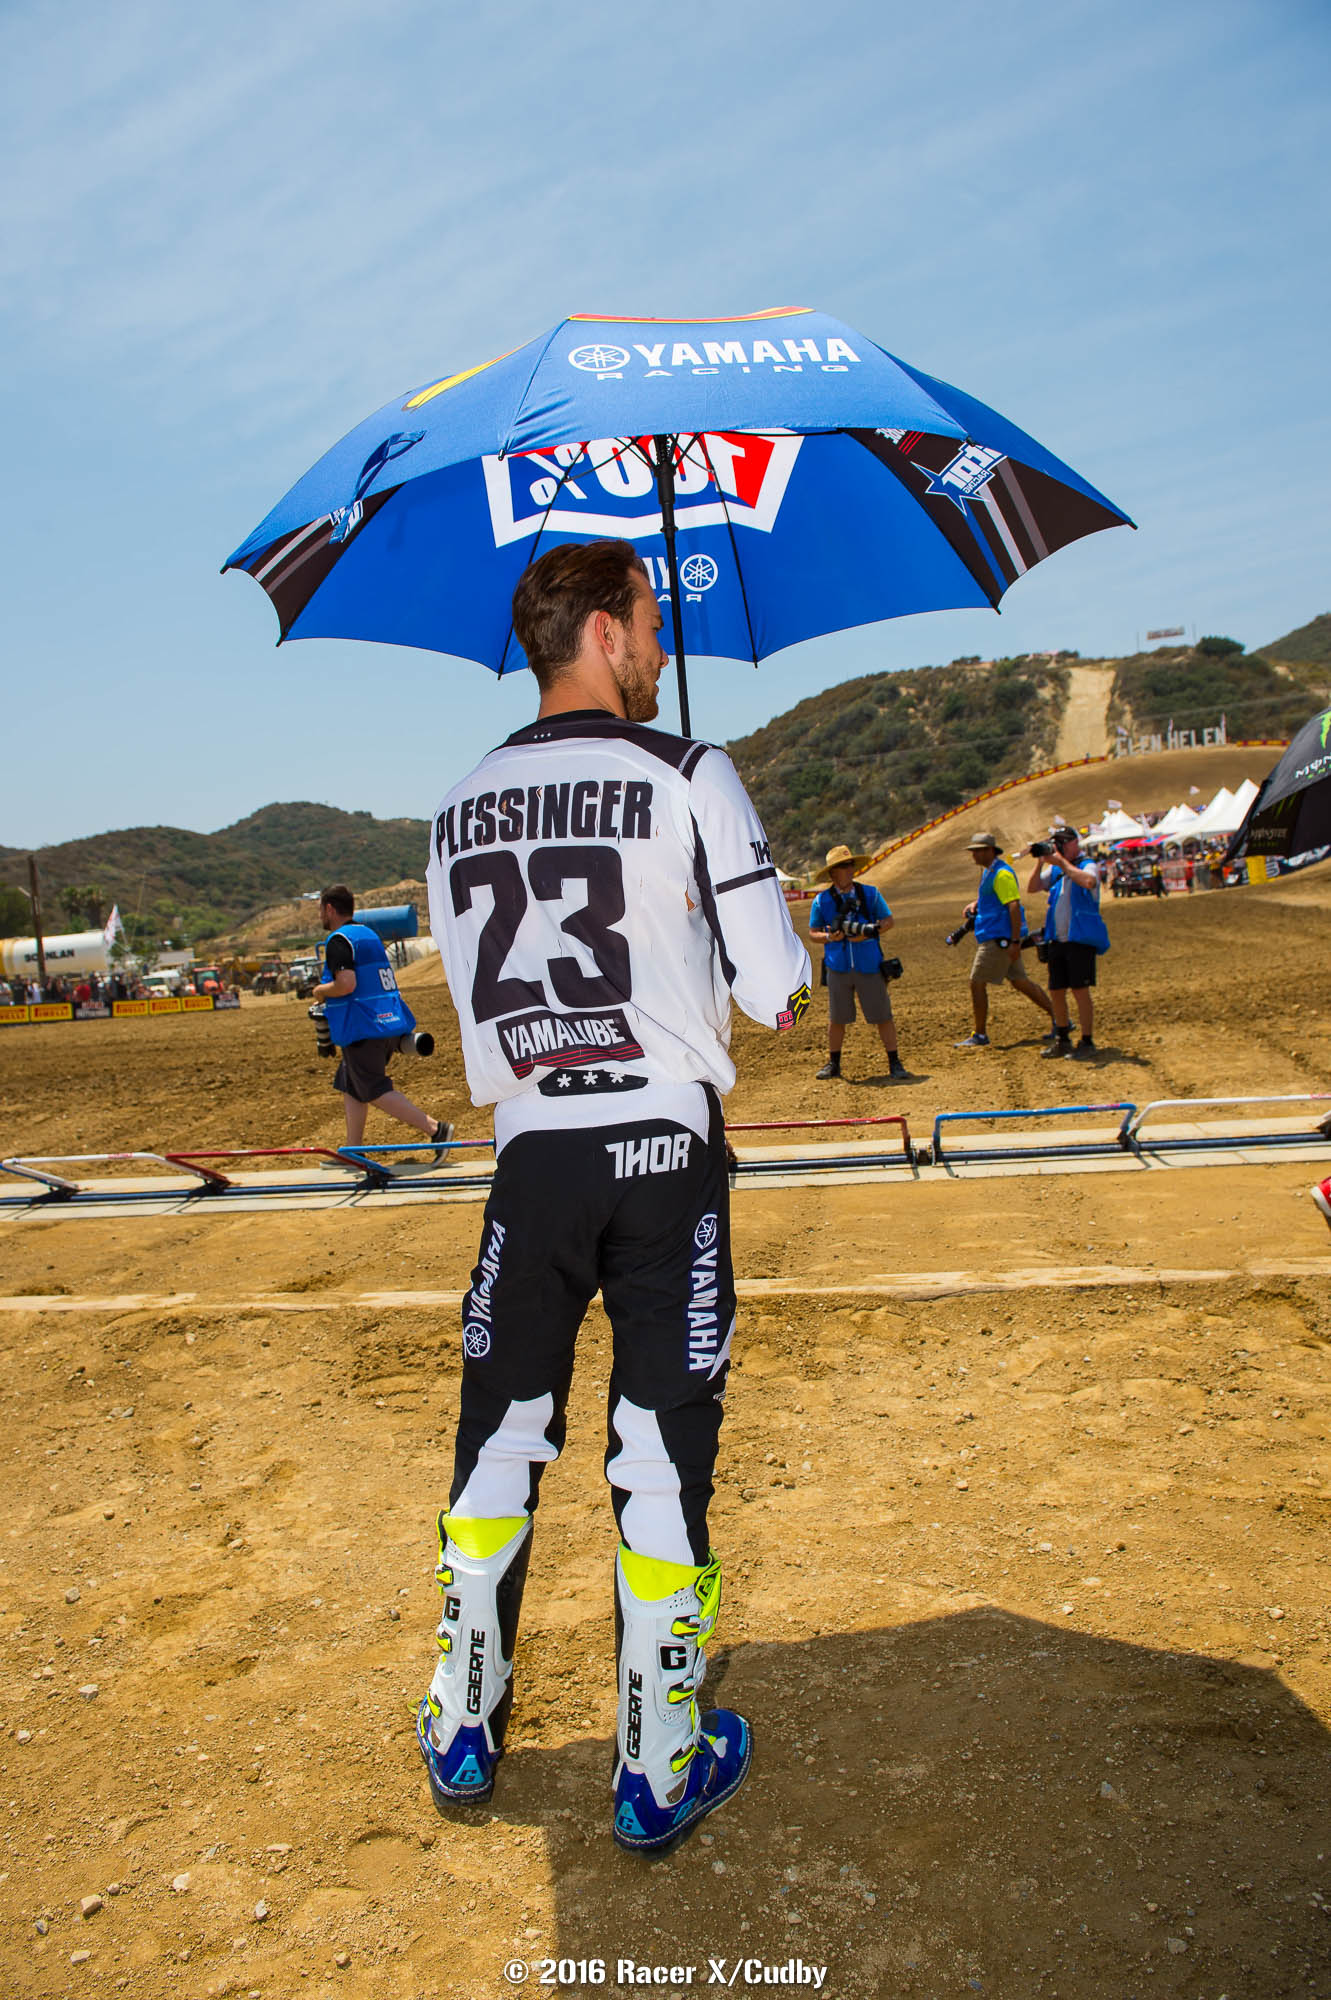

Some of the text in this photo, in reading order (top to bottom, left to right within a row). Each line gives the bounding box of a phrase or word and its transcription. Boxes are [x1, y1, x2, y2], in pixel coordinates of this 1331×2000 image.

[596, 364, 850, 381] RACING
[632, 338, 861, 367] YAMAHA
[436, 779, 653, 867] PLESSINGER
[24, 948, 75, 962] SCNLAN
[449, 845, 632, 1025] 23
[502, 1018, 626, 1060] YAMALUBE
[604, 1132, 692, 1180] THOR
[687, 1247, 718, 1371] YAMAHA
[466, 1628, 486, 1715] GAERNE
[626, 1668, 643, 1760] GAERNE
